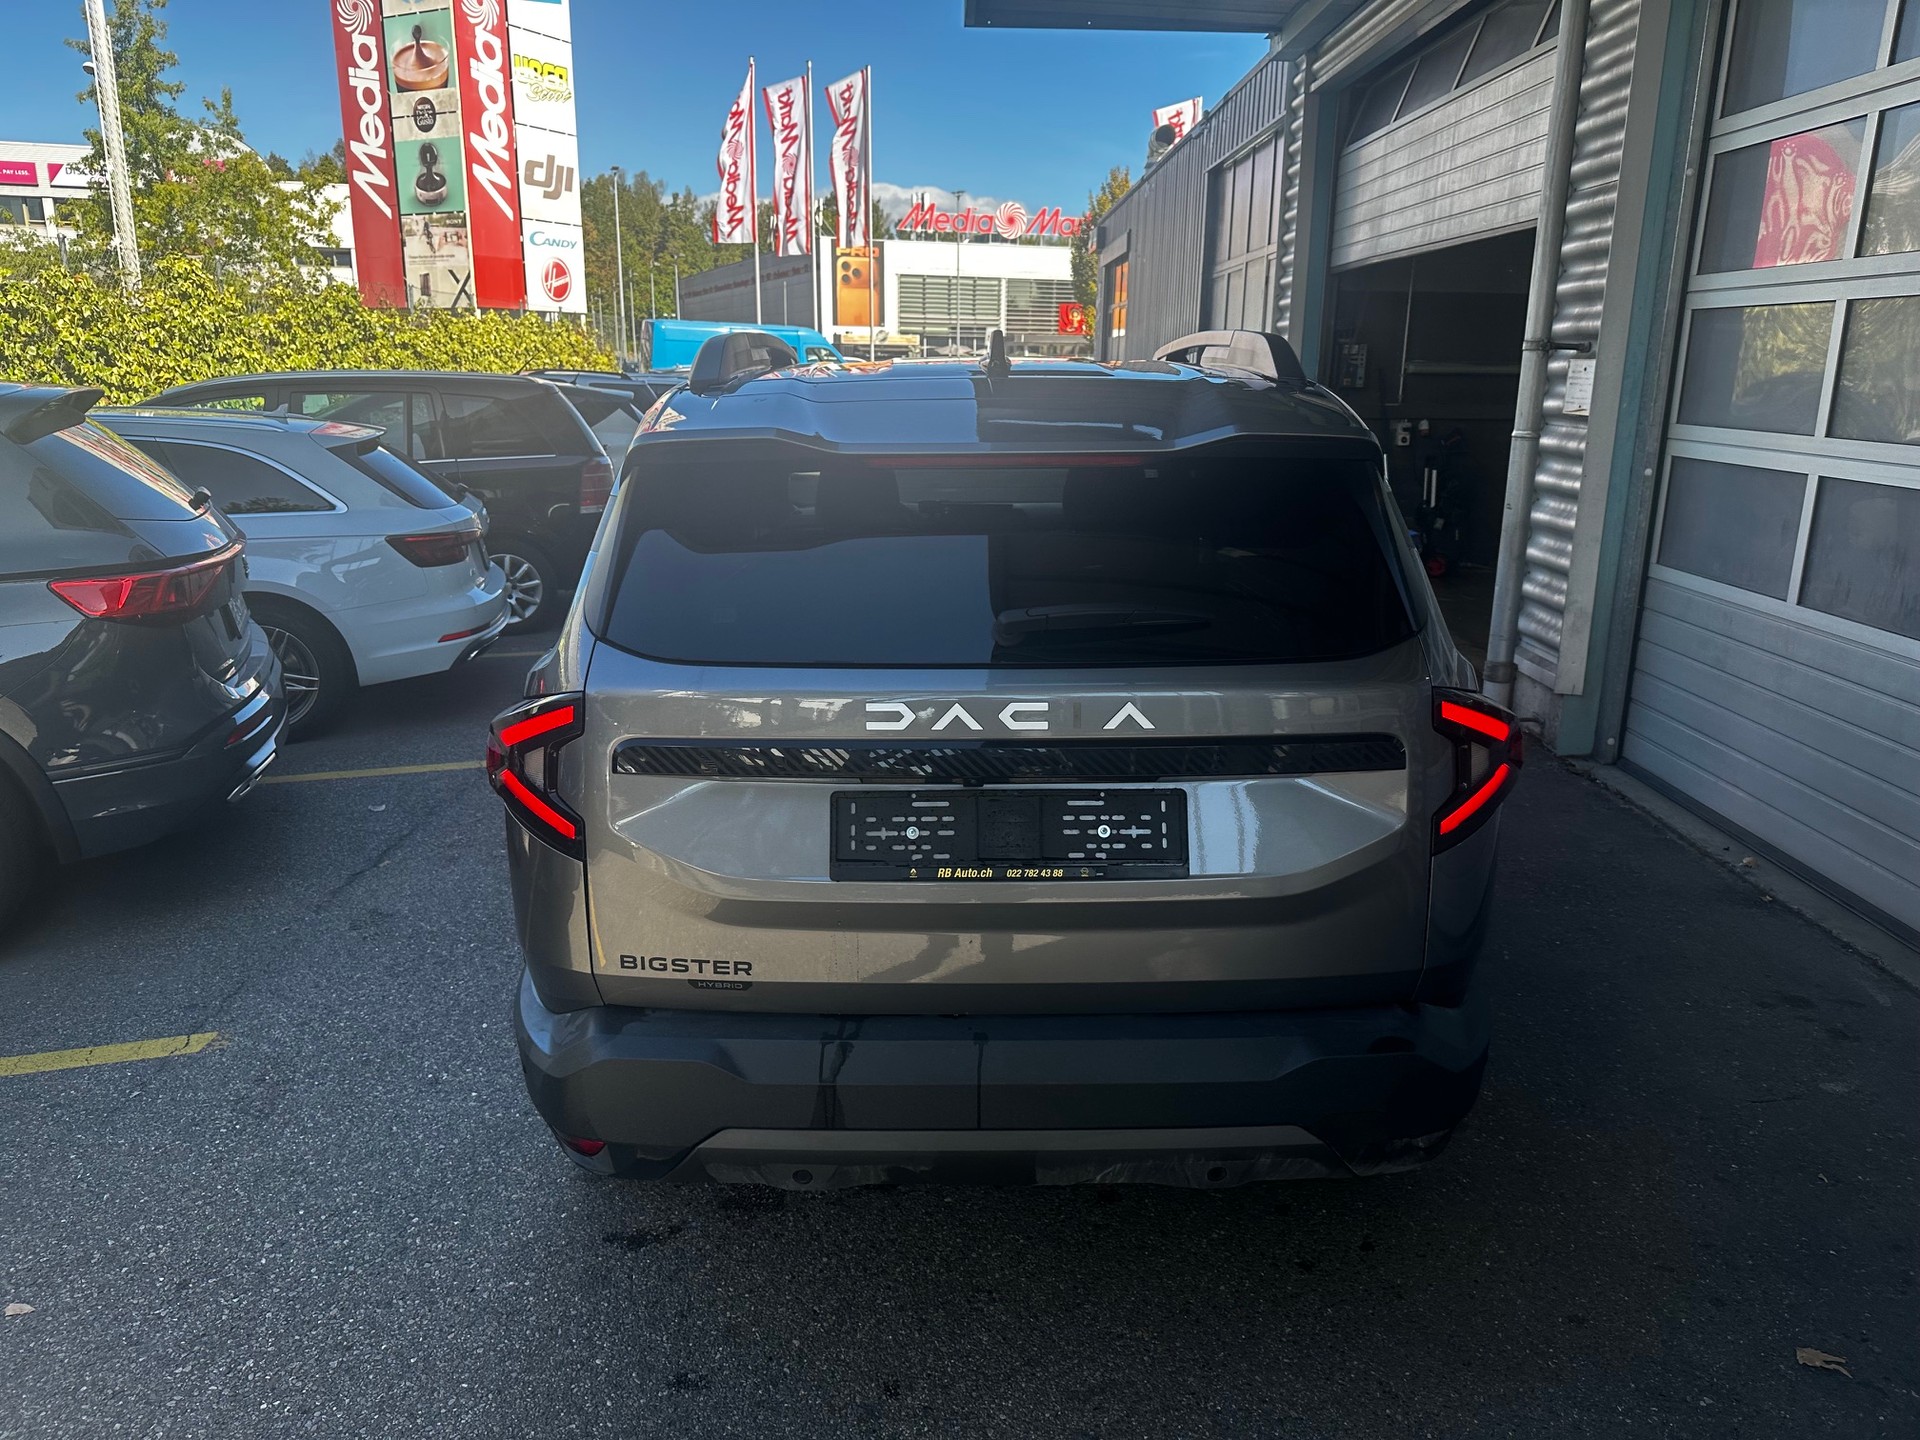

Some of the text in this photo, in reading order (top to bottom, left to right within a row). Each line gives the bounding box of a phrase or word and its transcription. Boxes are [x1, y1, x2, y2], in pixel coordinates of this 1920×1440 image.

[348, 33, 392, 219] Media
[469, 27, 514, 221] Media
[897, 202, 994, 234] Media
[937, 867, 1064, 878] RB Auto.ch 022 782 43 88
[619, 954, 753, 976] BIGSTER
